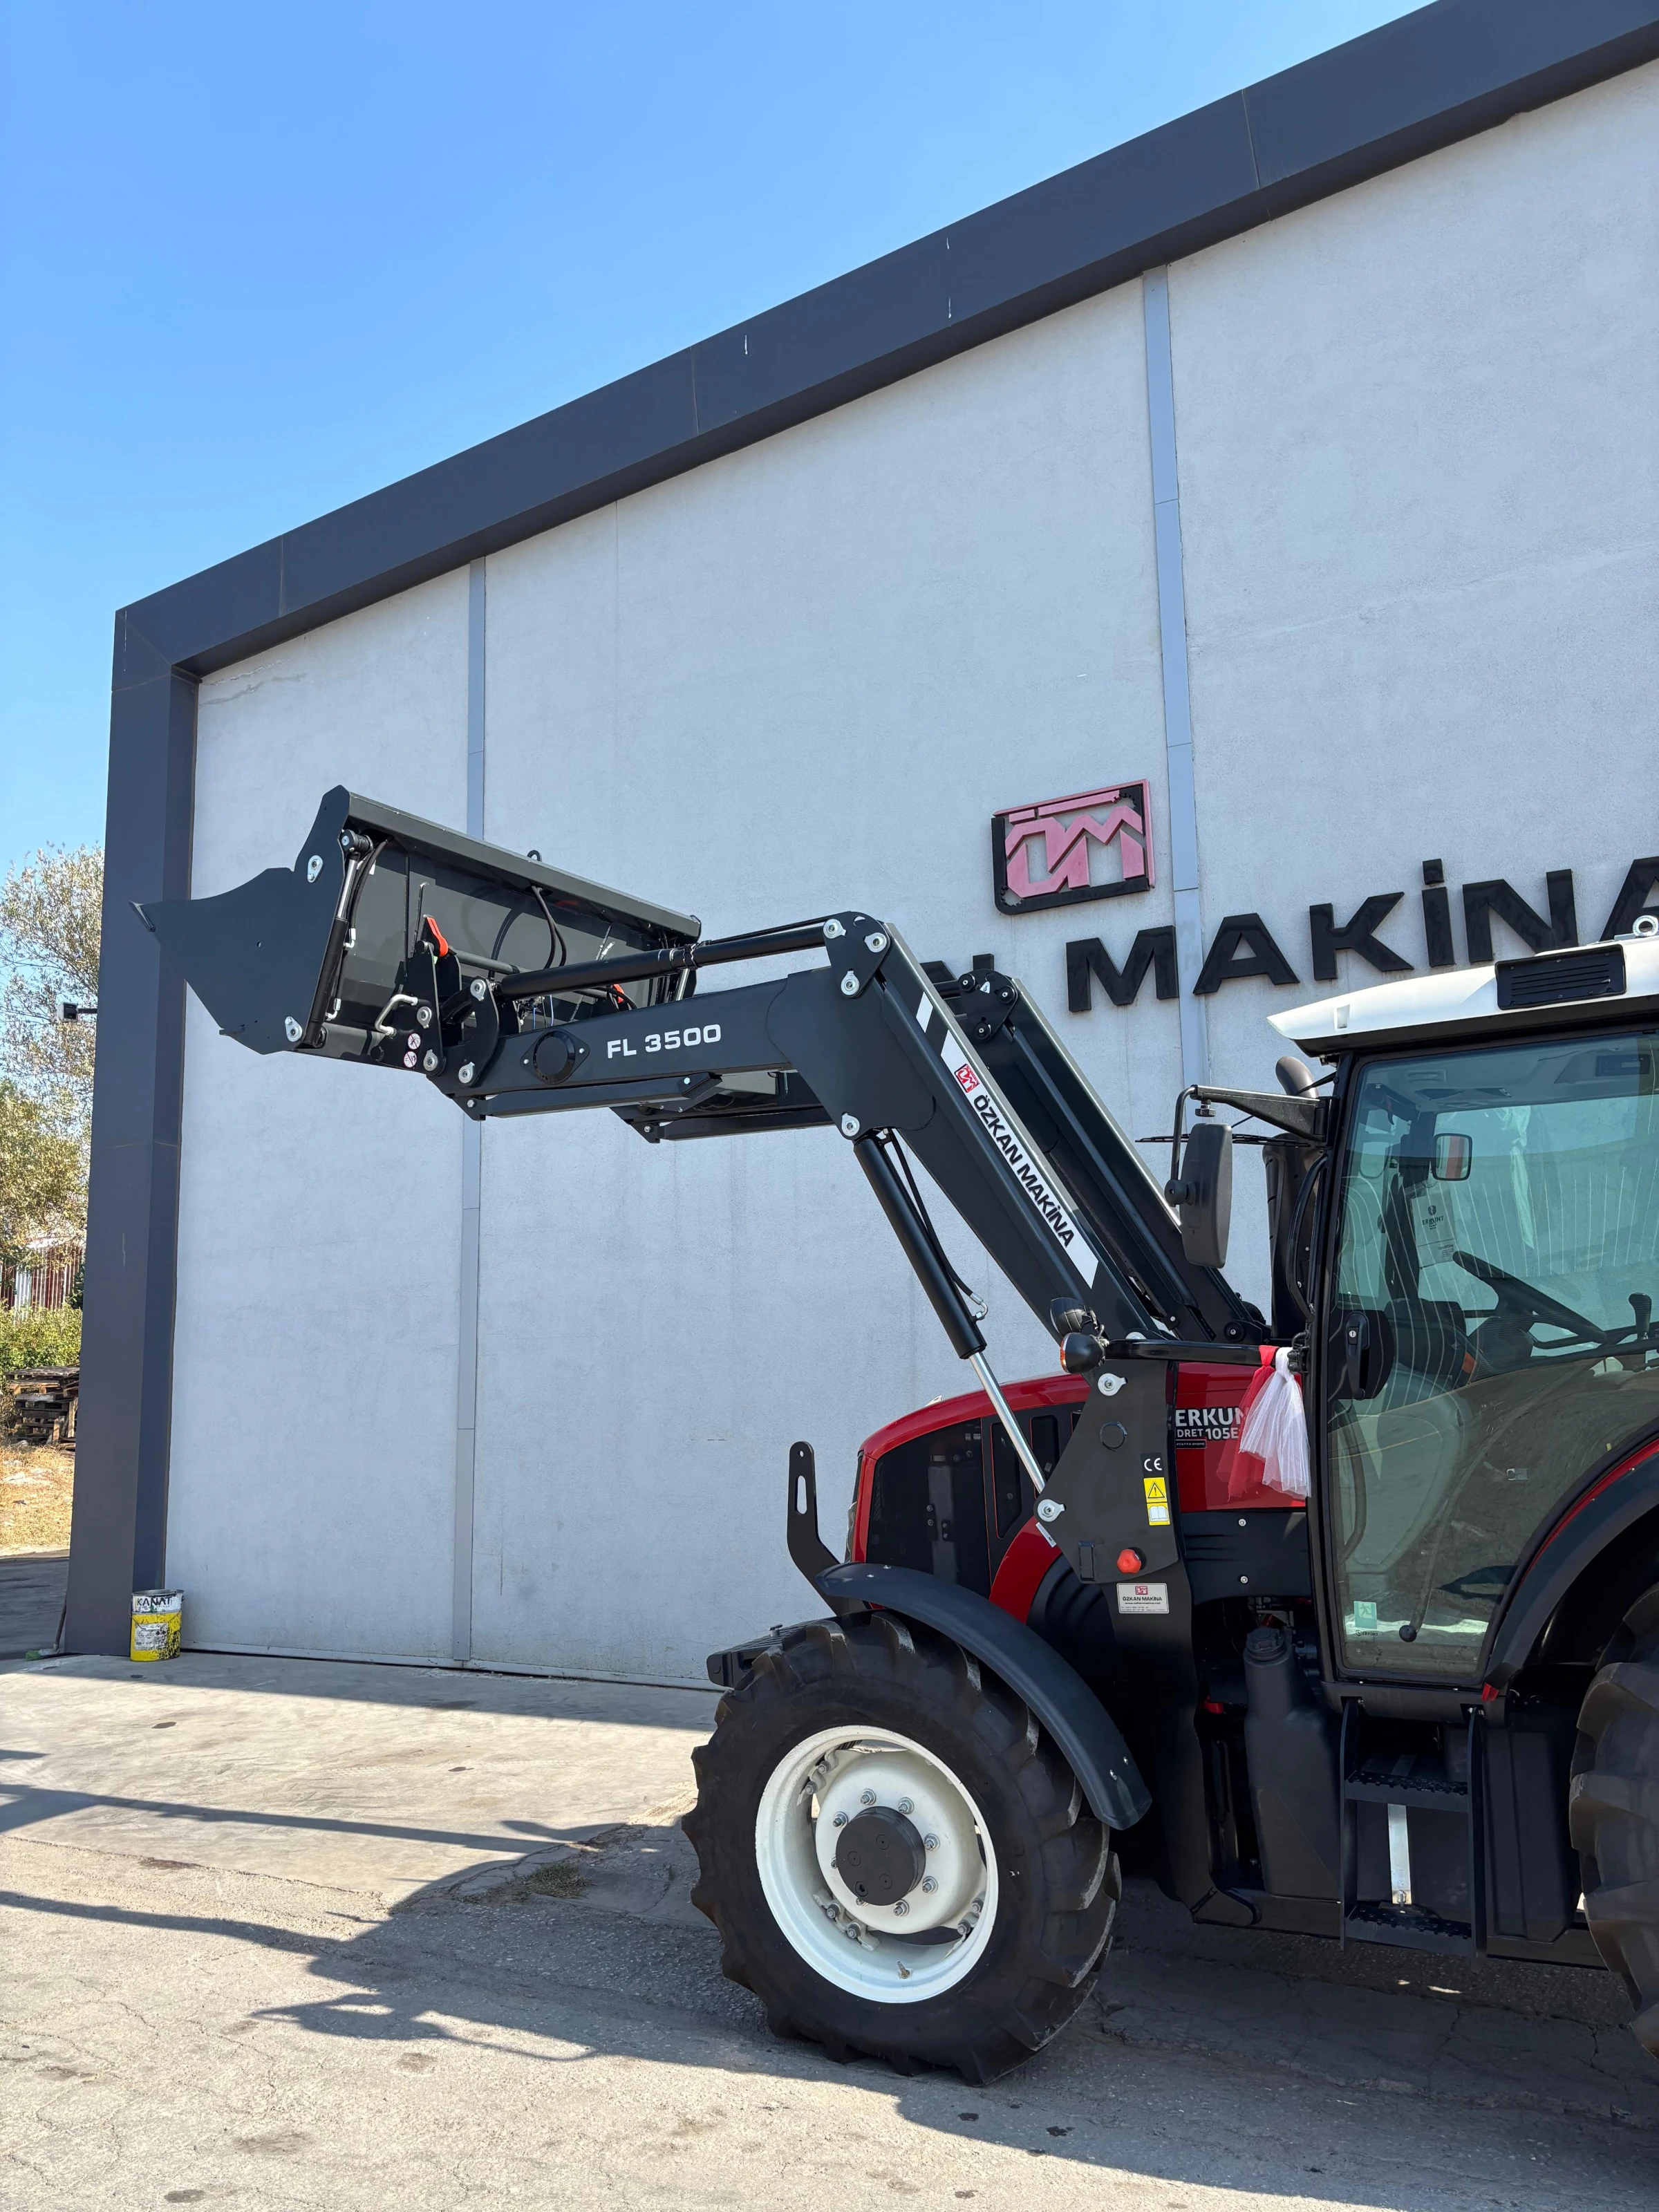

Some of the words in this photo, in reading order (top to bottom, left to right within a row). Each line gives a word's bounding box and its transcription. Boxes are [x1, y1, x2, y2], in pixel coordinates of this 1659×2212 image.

[607, 1038, 637, 1059] FL
[645, 1024, 722, 1053] 3500
[973, 1095, 1023, 1166] ÖZKAN
[1017, 1164, 1076, 1248] MAKİNA
[1175, 1407, 1246, 1427] ERKUN
[1177, 1428, 1203, 1438] DRET
[1206, 1427, 1239, 1440] 105E
[1144, 1457, 1163, 1472] CE
[137, 1597, 171, 1606] KANAT
